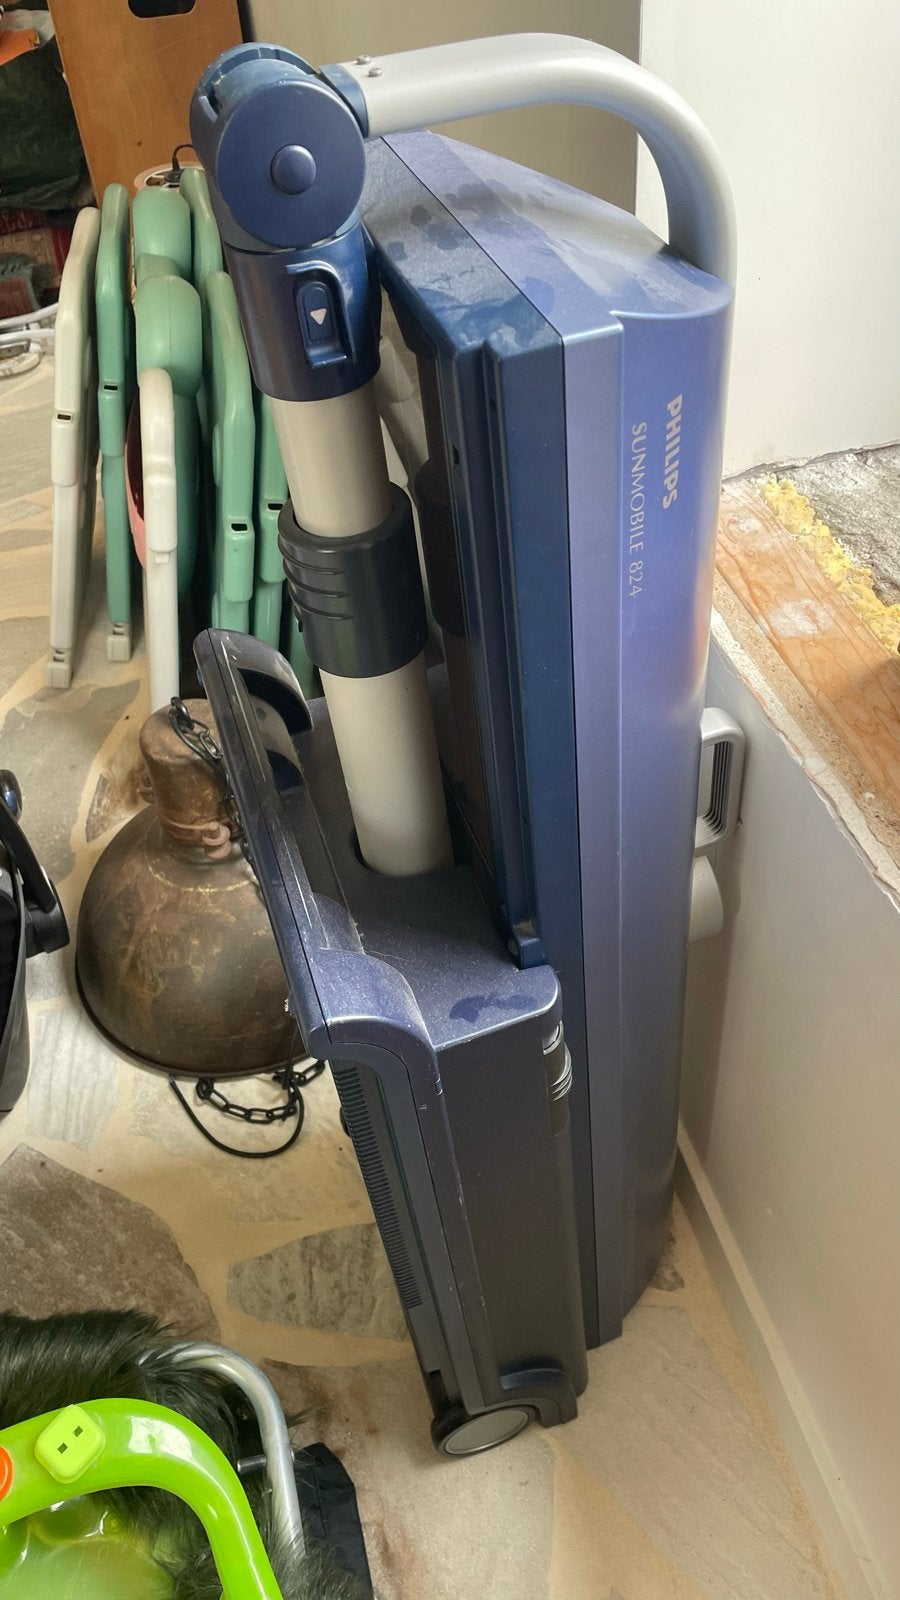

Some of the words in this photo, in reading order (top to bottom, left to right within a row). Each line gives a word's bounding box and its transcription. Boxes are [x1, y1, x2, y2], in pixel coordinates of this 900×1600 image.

[629, 422, 647, 555] SUNMOBILE
[662, 394, 683, 510] PHILIPS
[628, 560, 644, 598] 824
